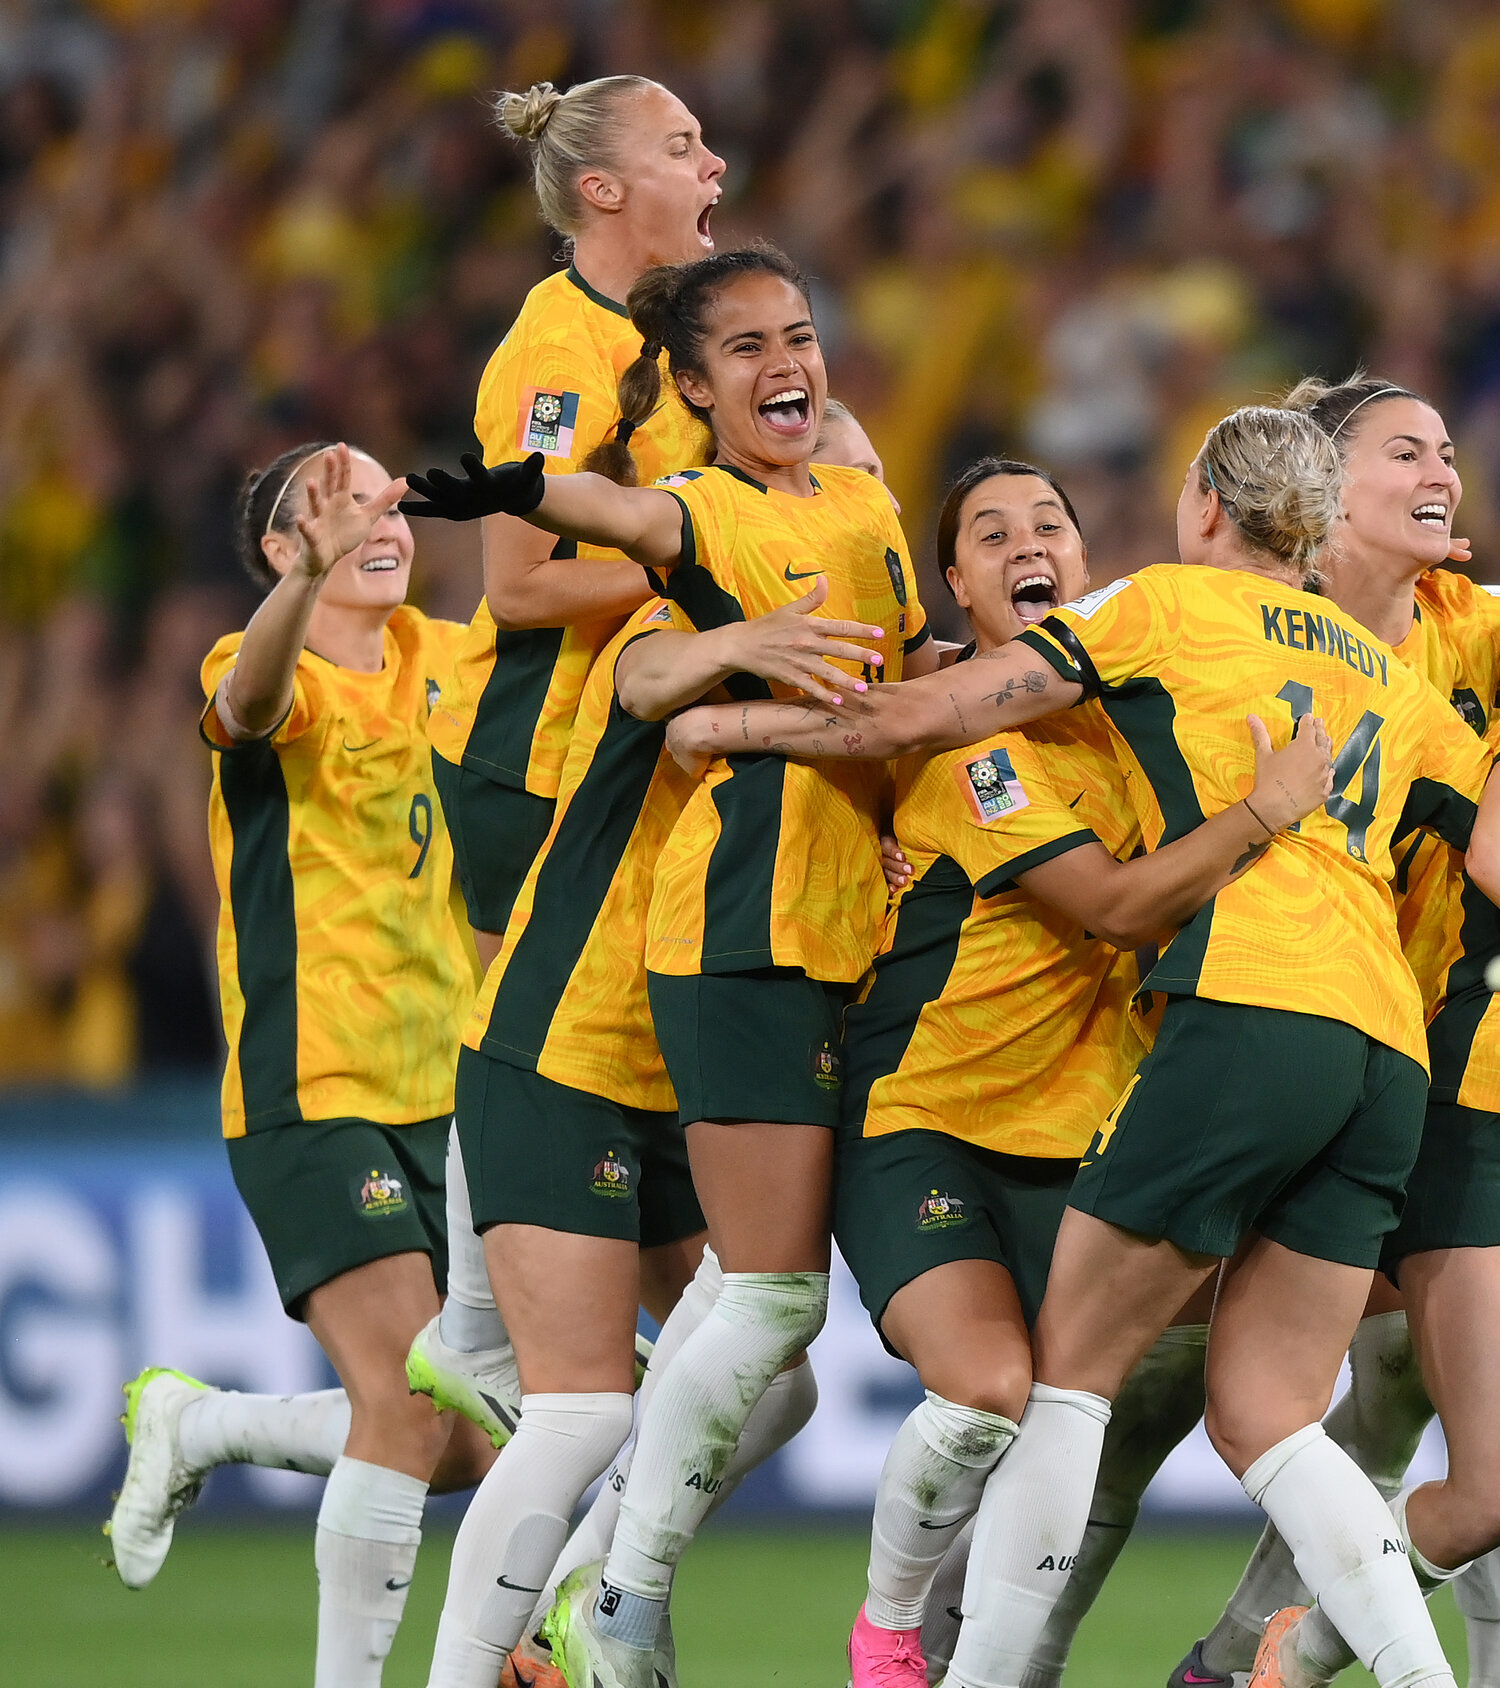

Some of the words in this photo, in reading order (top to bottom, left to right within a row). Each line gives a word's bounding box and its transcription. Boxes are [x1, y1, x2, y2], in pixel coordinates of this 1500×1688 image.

[1260, 603, 1388, 688] KENNEDY
[408, 793, 432, 880] 9
[922, 1213, 963, 1225] AUSTRALIA
[685, 1466, 724, 1495] AU
